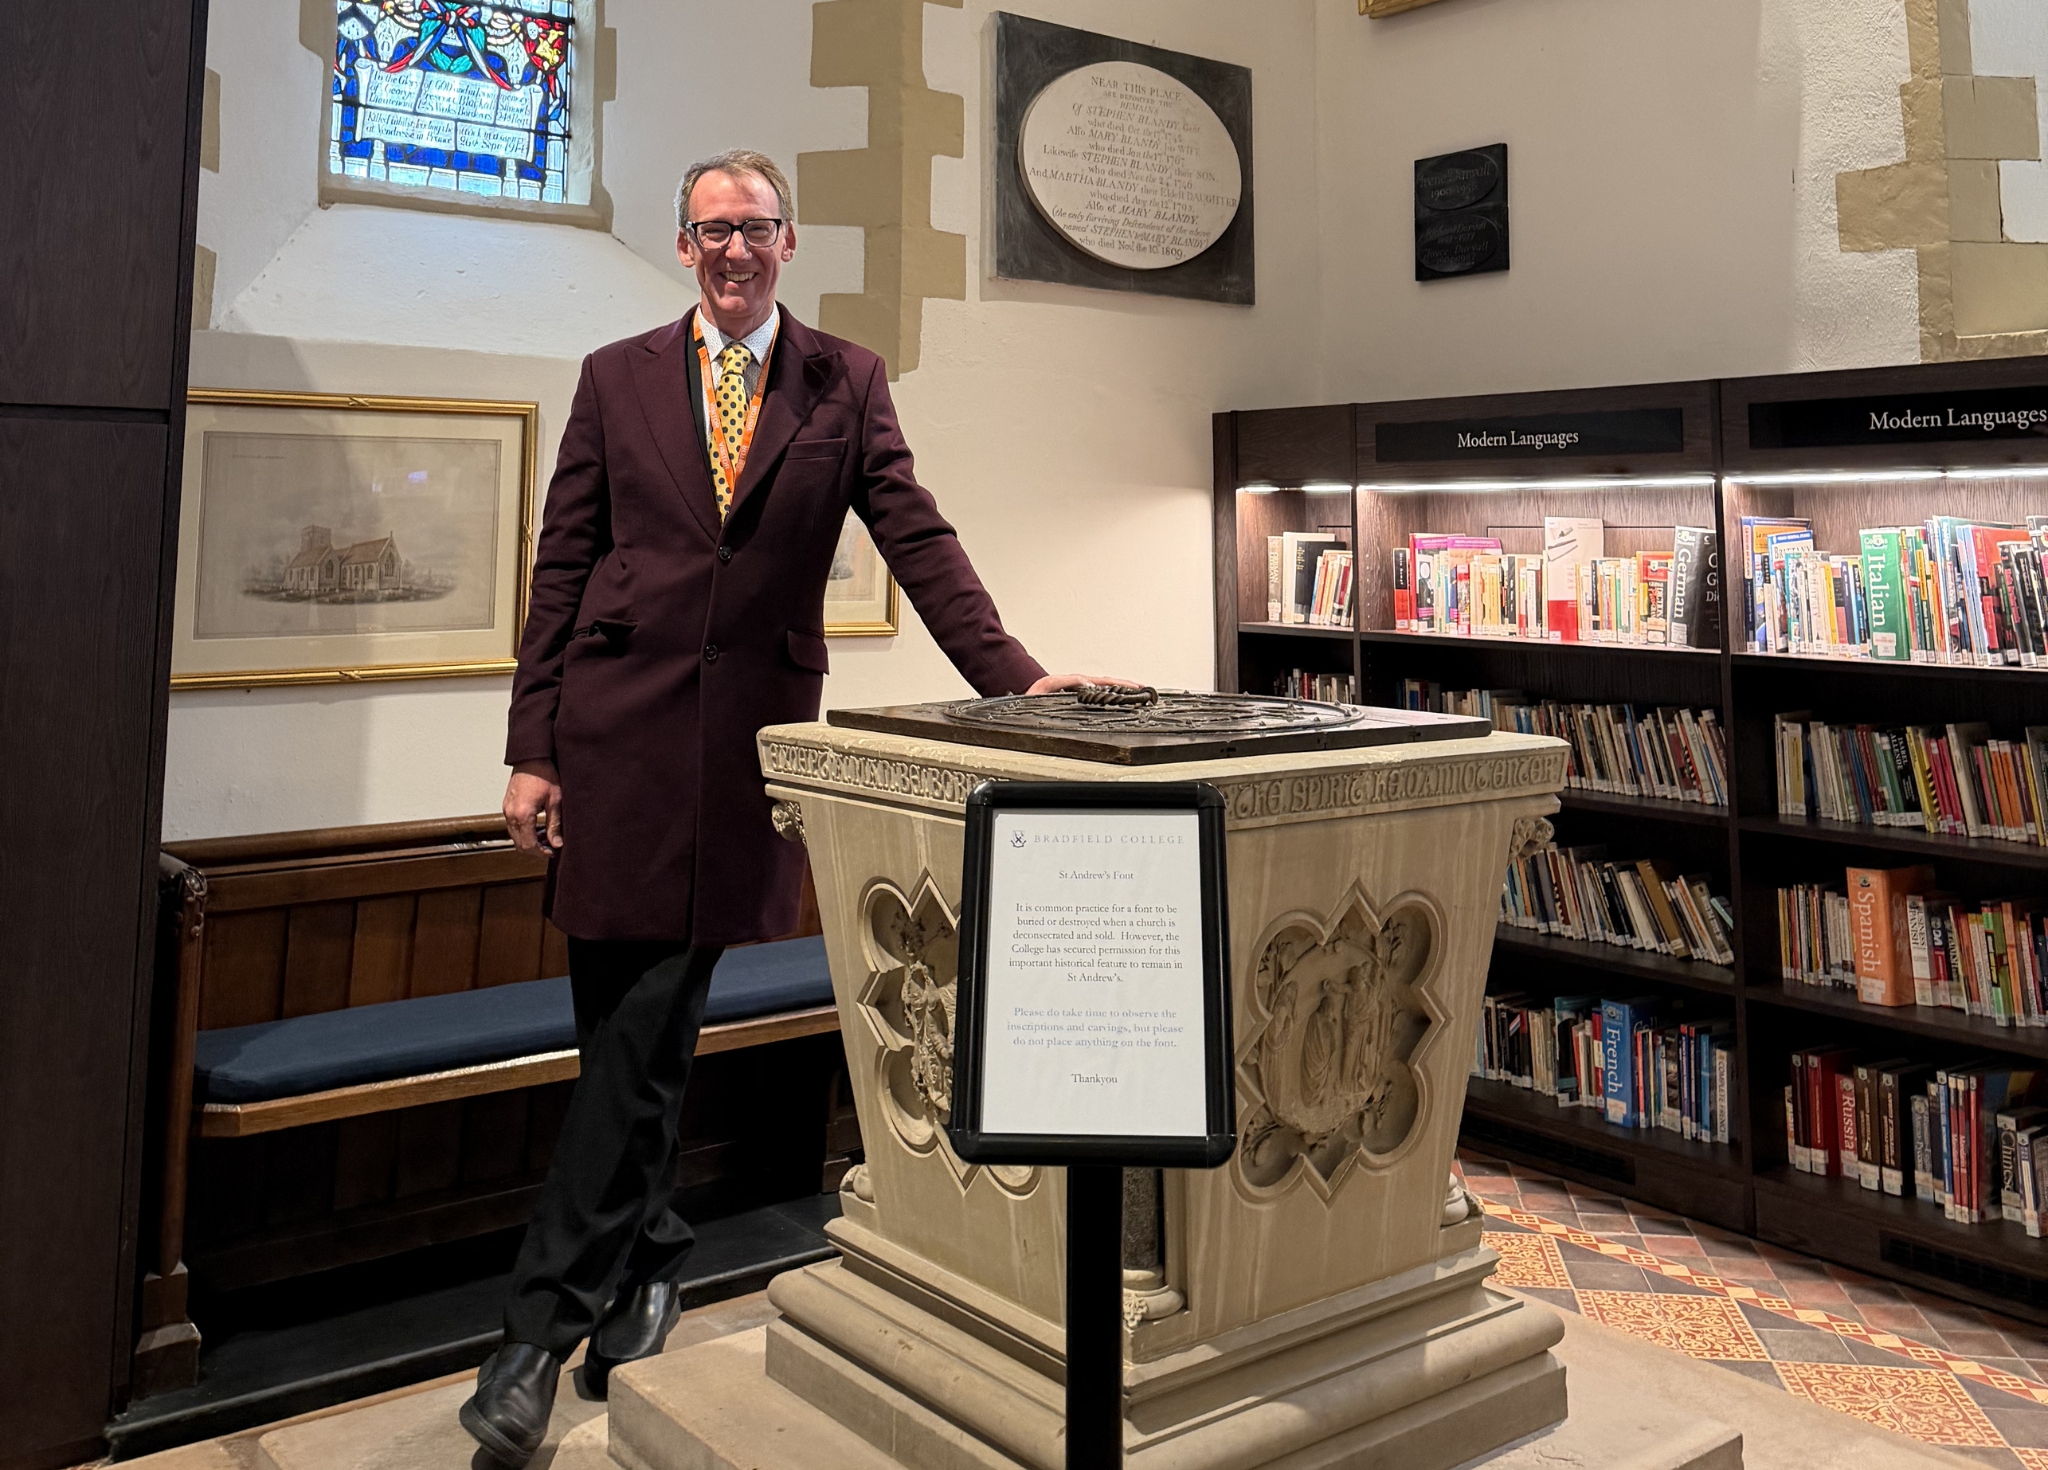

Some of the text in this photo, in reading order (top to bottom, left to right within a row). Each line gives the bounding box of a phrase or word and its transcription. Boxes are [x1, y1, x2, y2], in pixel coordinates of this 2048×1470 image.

[1092, 76, 1181, 101] NEAR THIS PLACE
[1087, 105, 1135, 122] STEPHEN
[1120, 102, 1159, 114] REMAINS
[1088, 118, 1105, 128] who
[1107, 121, 1124, 132] died
[1089, 129, 1118, 141] MARY
[1089, 142, 1105, 152] who
[1108, 145, 1125, 156] died
[1082, 151, 1128, 167] STEPHEN
[1088, 165, 1105, 175] who
[1108, 168, 1126, 179] died
[1029, 167, 1047, 178] And
[1049, 170, 1094, 185] MARTHA
[1097, 177, 1139, 192] BLANDY
[1187, 191, 1237, 208] DAUGHTER
[1090, 190, 1108, 202] who
[1110, 192, 1129, 203] died
[1107, 205, 1116, 213] of
[1119, 206, 1151, 218] MARY
[1068, 211, 1085, 222] only
[1166, 225, 1176, 234] of
[1176, 225, 1187, 235] the
[1189, 228, 1211, 237] above
[1079, 237, 1096, 246] who
[1098, 238, 1115, 249] died
[746, 406, 758, 431] VISITOR
[1869, 408, 2047, 430] Modern Languages
[1458, 429, 1579, 451] Modern Languages
[719, 442, 730, 469] VISITOR
[1674, 548, 1692, 619] German
[1867, 552, 1890, 627] Italian
[1890, 733, 1903, 770] ALLENDE
[1898, 737, 1908, 765] ISABEL
[1035, 835, 1112, 843] BRADFIELD
[1017, 903, 1022, 911] It
[1026, 903, 1032, 911] is
[1076, 906, 1109, 915] practice
[1112, 904, 1124, 912] for
[1135, 904, 1152, 913] font
[1167, 905, 1177, 913] be
[1018, 917, 1044, 925] buried
[1059, 917, 1100, 928] destroyed
[1103, 918, 1126, 926] when
[1137, 918, 1166, 927] church
[1169, 919, 1175, 927] is
[1013, 930, 1074, 939] deconsecrated
[1077, 931, 1092, 939] and
[1095, 931, 1114, 940] sold.
[1122, 932, 1163, 941] However,
[1853, 892, 1881, 972] Spanish
[1012, 944, 1180, 956] College has secured permission for this
[1010, 958, 1051, 969] important
[1055, 959, 1094, 967] historical
[1098, 959, 1127, 968] feature
[1068, 973, 1076, 981] St
[1015, 1008, 1043, 1016] Please
[1047, 1008, 1059, 1016] do
[1063, 1008, 1082, 1016] take
[1086, 1009, 1106, 1017] time
[1162, 1010, 1176, 1018] the
[1008, 1022, 1183, 1035] inscriptions and carvings, but please
[1047, 1037, 1072, 1048] place
[1075, 1038, 1118, 1048] anything
[1137, 1039, 1151, 1047] the
[1155, 1039, 1176, 1047] font.
[1606, 1026, 1623, 1094] French
[1071, 1074, 1117, 1085] Thankyou
[1718, 1061, 1726, 1102] COMPLETE
[1842, 1094, 1856, 1151] Russia
